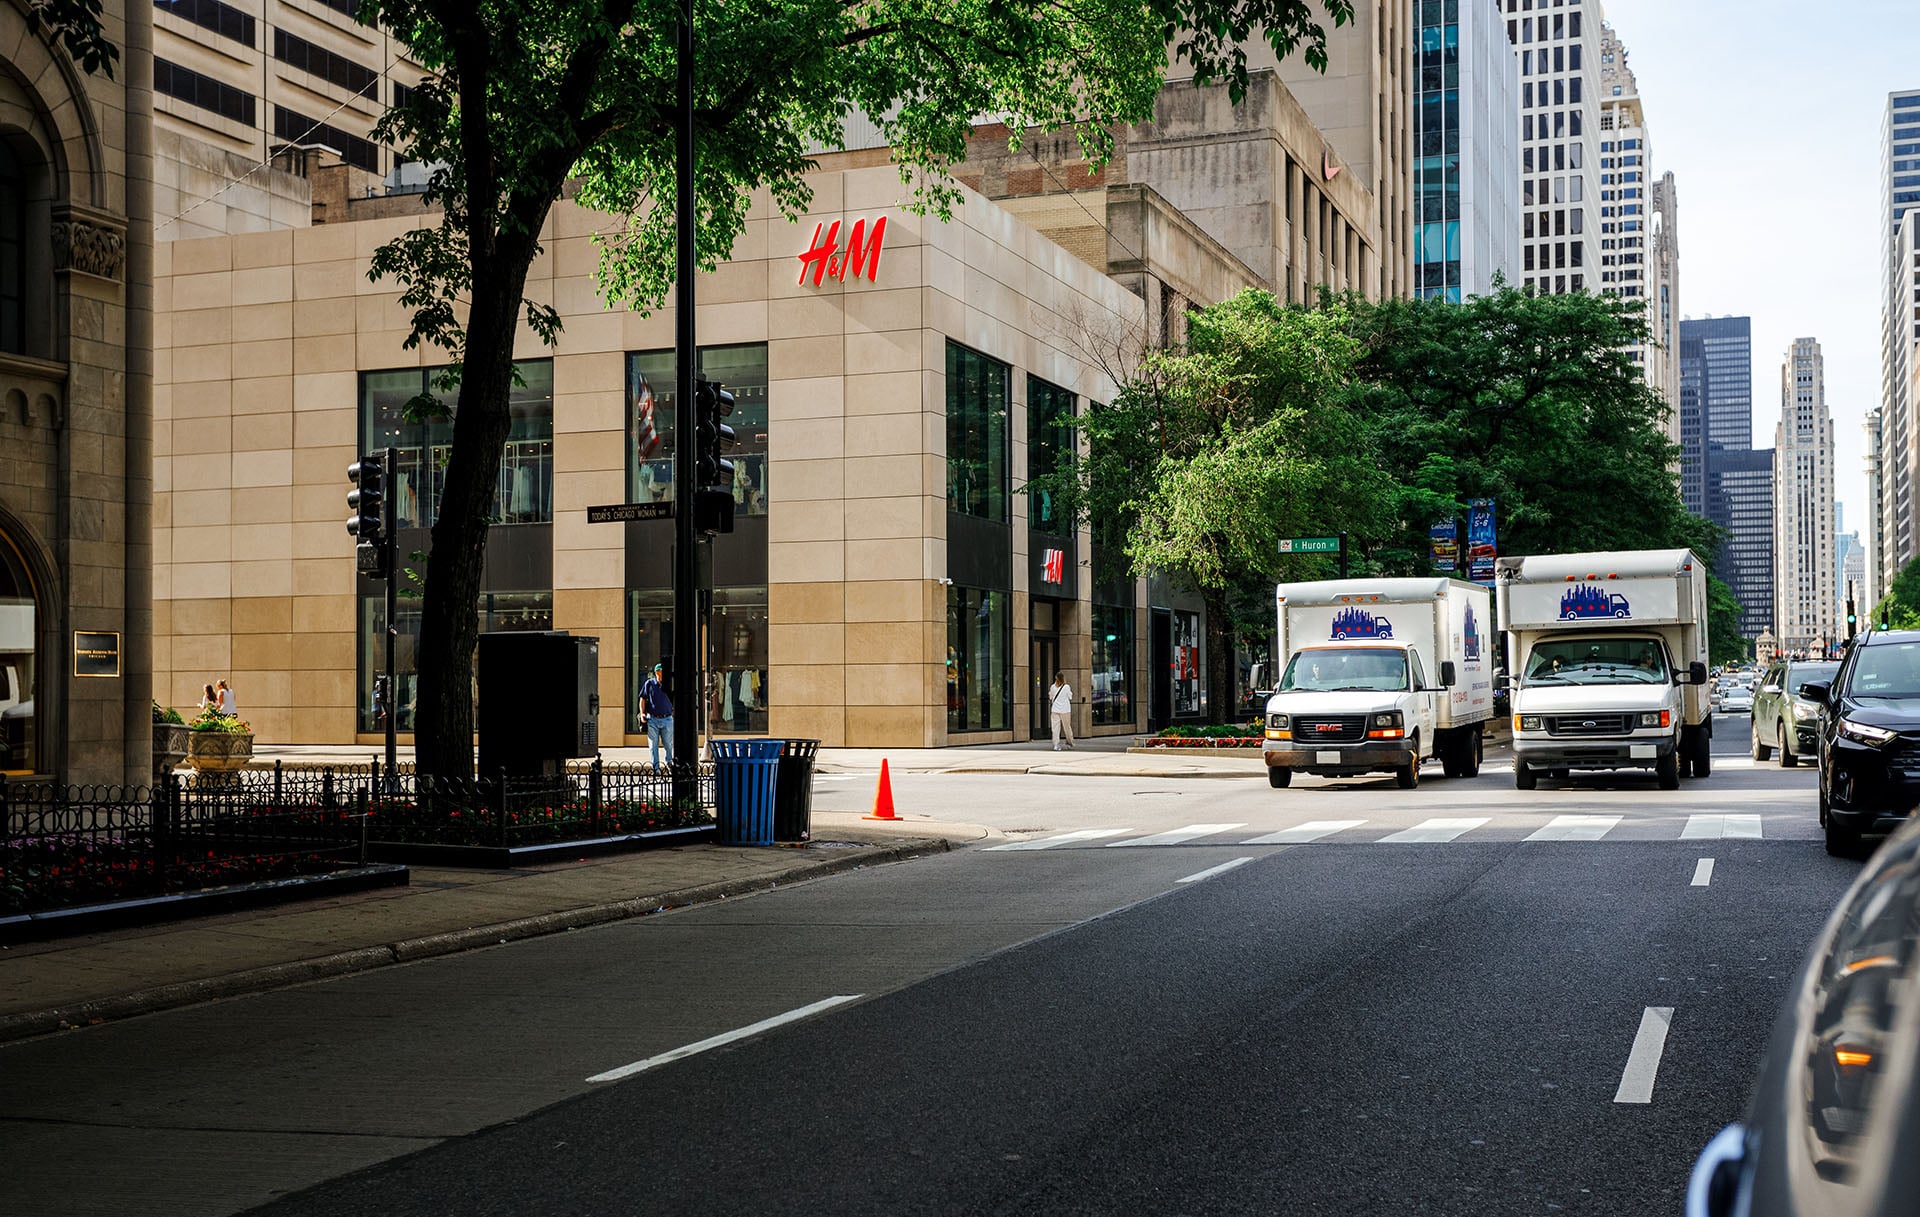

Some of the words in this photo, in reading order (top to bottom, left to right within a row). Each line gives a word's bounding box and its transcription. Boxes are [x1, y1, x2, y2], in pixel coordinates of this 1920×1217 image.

[797, 215, 887, 287] H&M
[613, 510, 635, 520] CHICAGO
[637, 508, 657, 518] WOMAN
[1301, 541, 1327, 550] Huron
[1043, 549, 1064, 584] H&M
[1315, 723, 1343, 732] GMC
